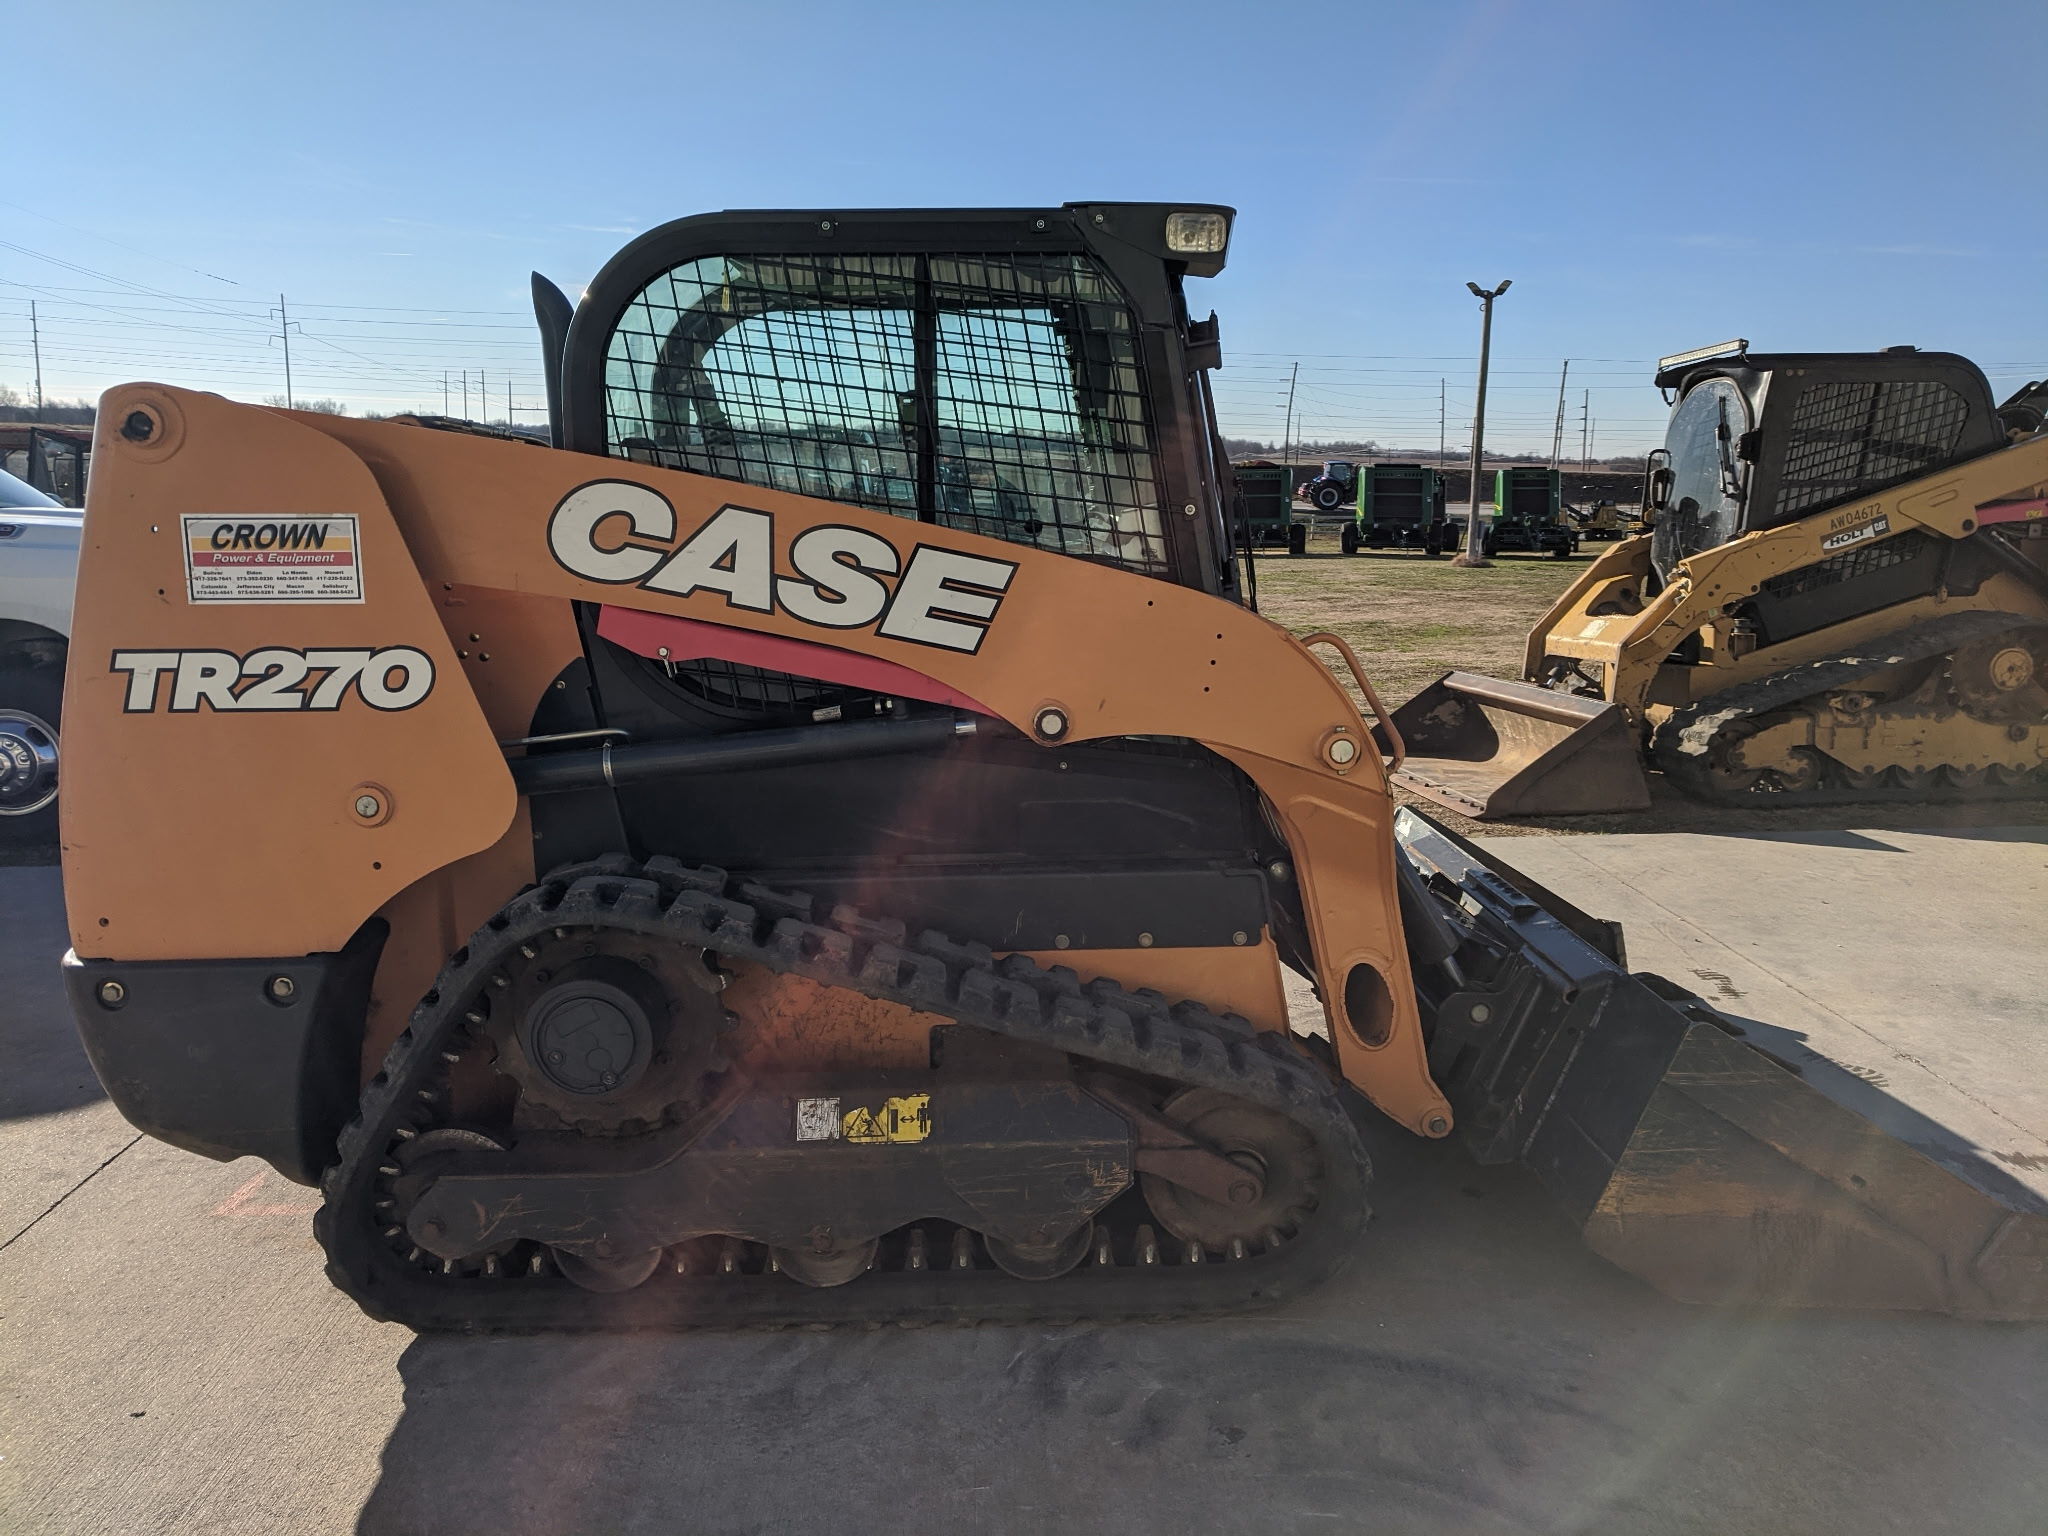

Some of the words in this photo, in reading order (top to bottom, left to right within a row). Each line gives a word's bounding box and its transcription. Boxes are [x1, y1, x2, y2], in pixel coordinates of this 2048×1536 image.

[1830, 503, 1883, 531] AW04672
[1873, 520, 1887, 532] CAT
[211, 523, 329, 550] CROWN
[1829, 528, 1865, 547] HOLT
[212, 553, 252, 563] Power
[254, 554, 264, 563] &
[267, 553, 335, 564] Equipment
[546, 478, 1021, 656] CASE
[109, 645, 436, 713] TR270
